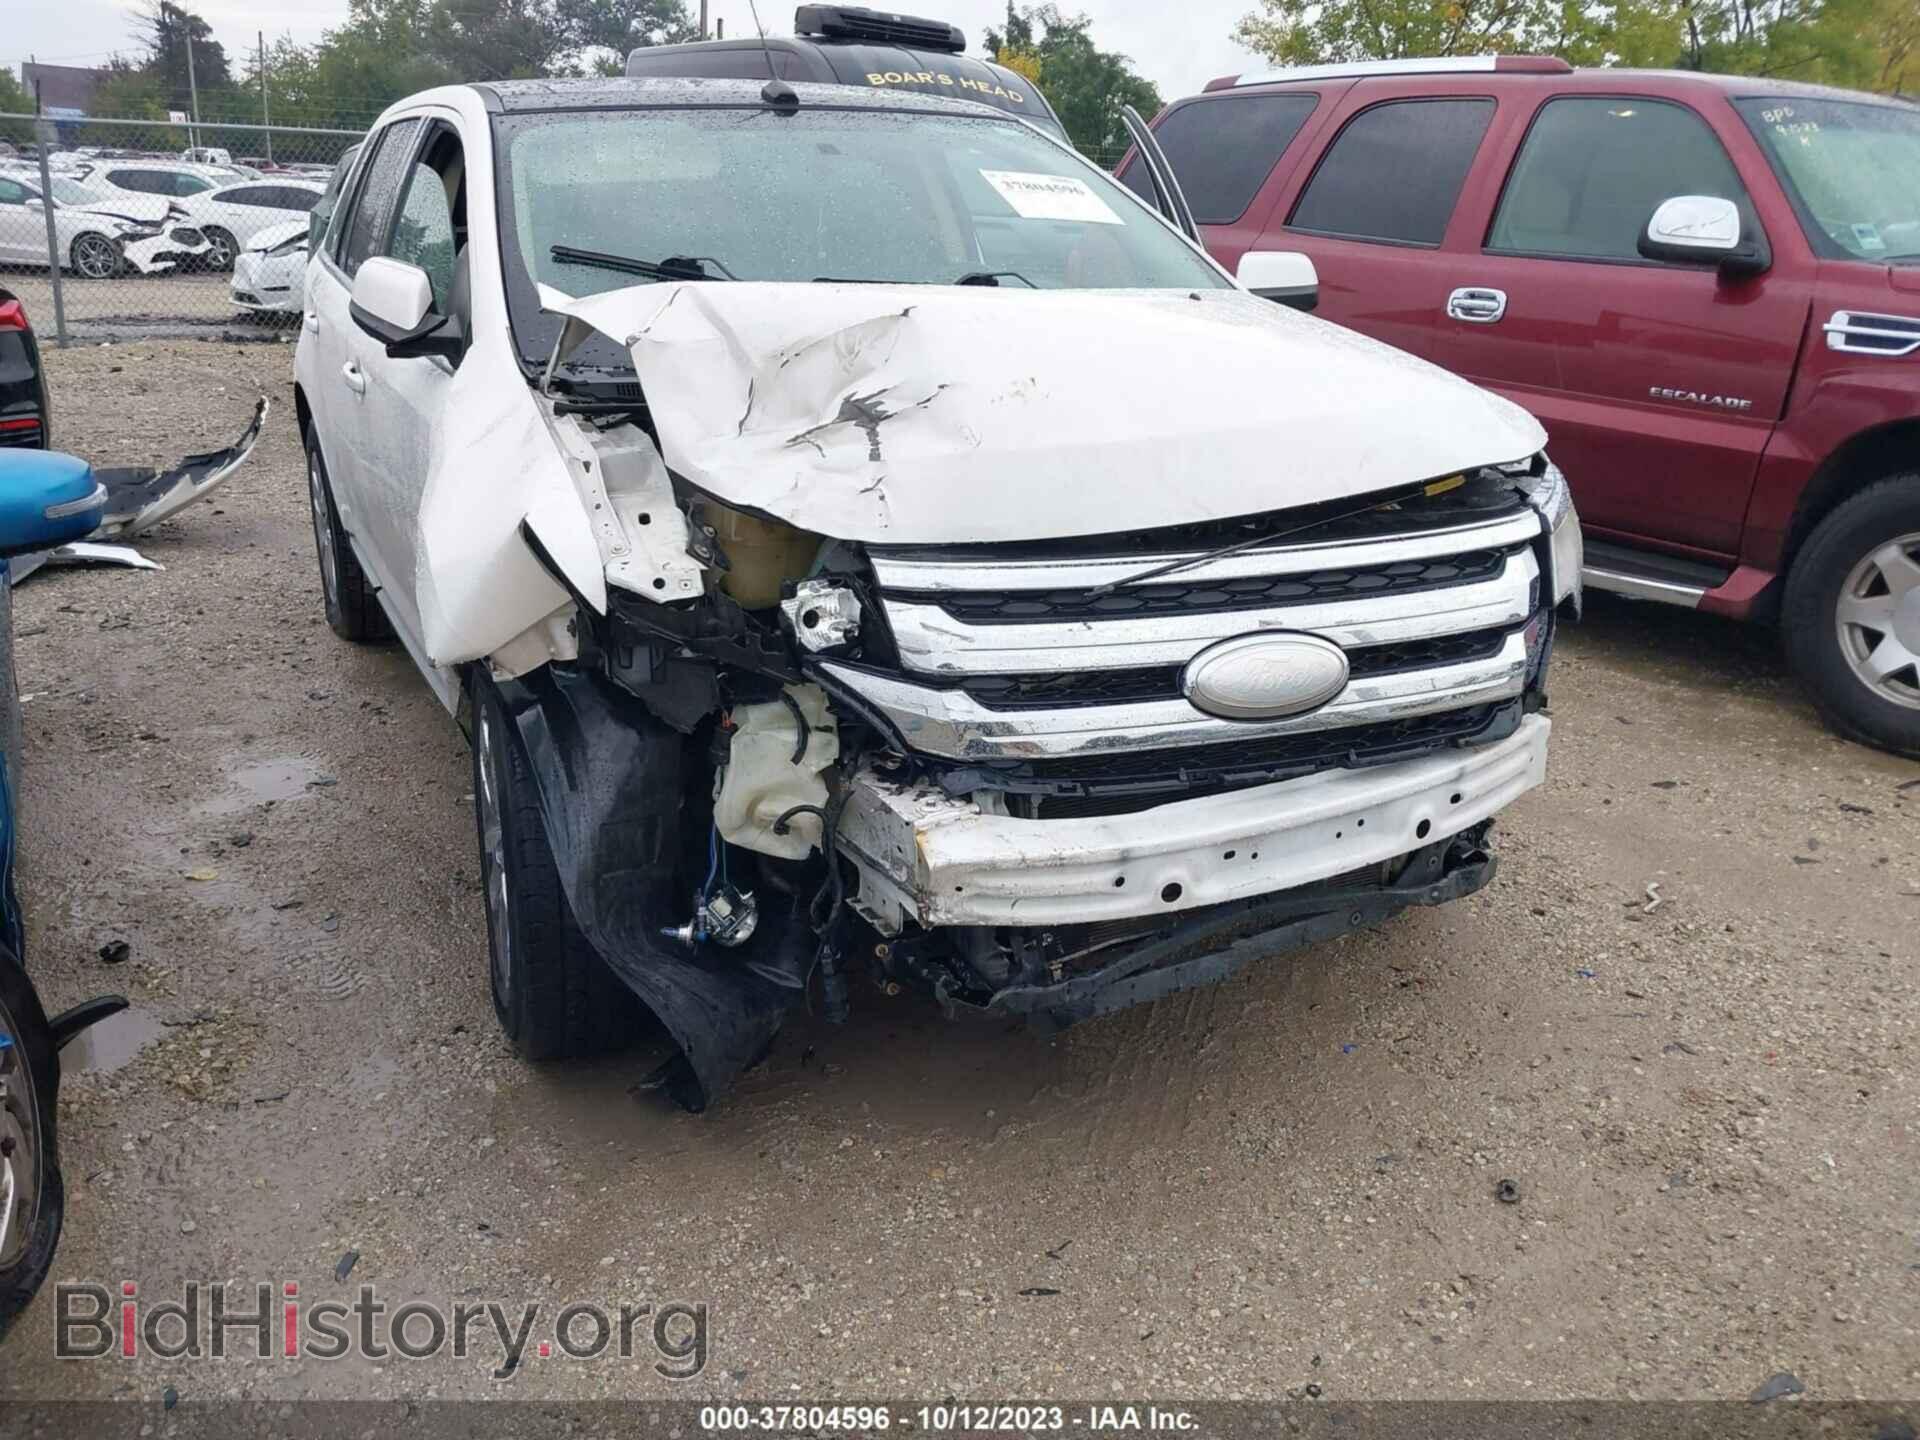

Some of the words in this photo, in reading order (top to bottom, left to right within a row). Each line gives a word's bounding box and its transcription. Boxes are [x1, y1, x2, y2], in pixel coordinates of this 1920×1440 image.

[866, 71, 954, 86] BOAR'S
[959, 77, 1024, 103] HEAD
[1649, 386, 1752, 409] ESCALADE
